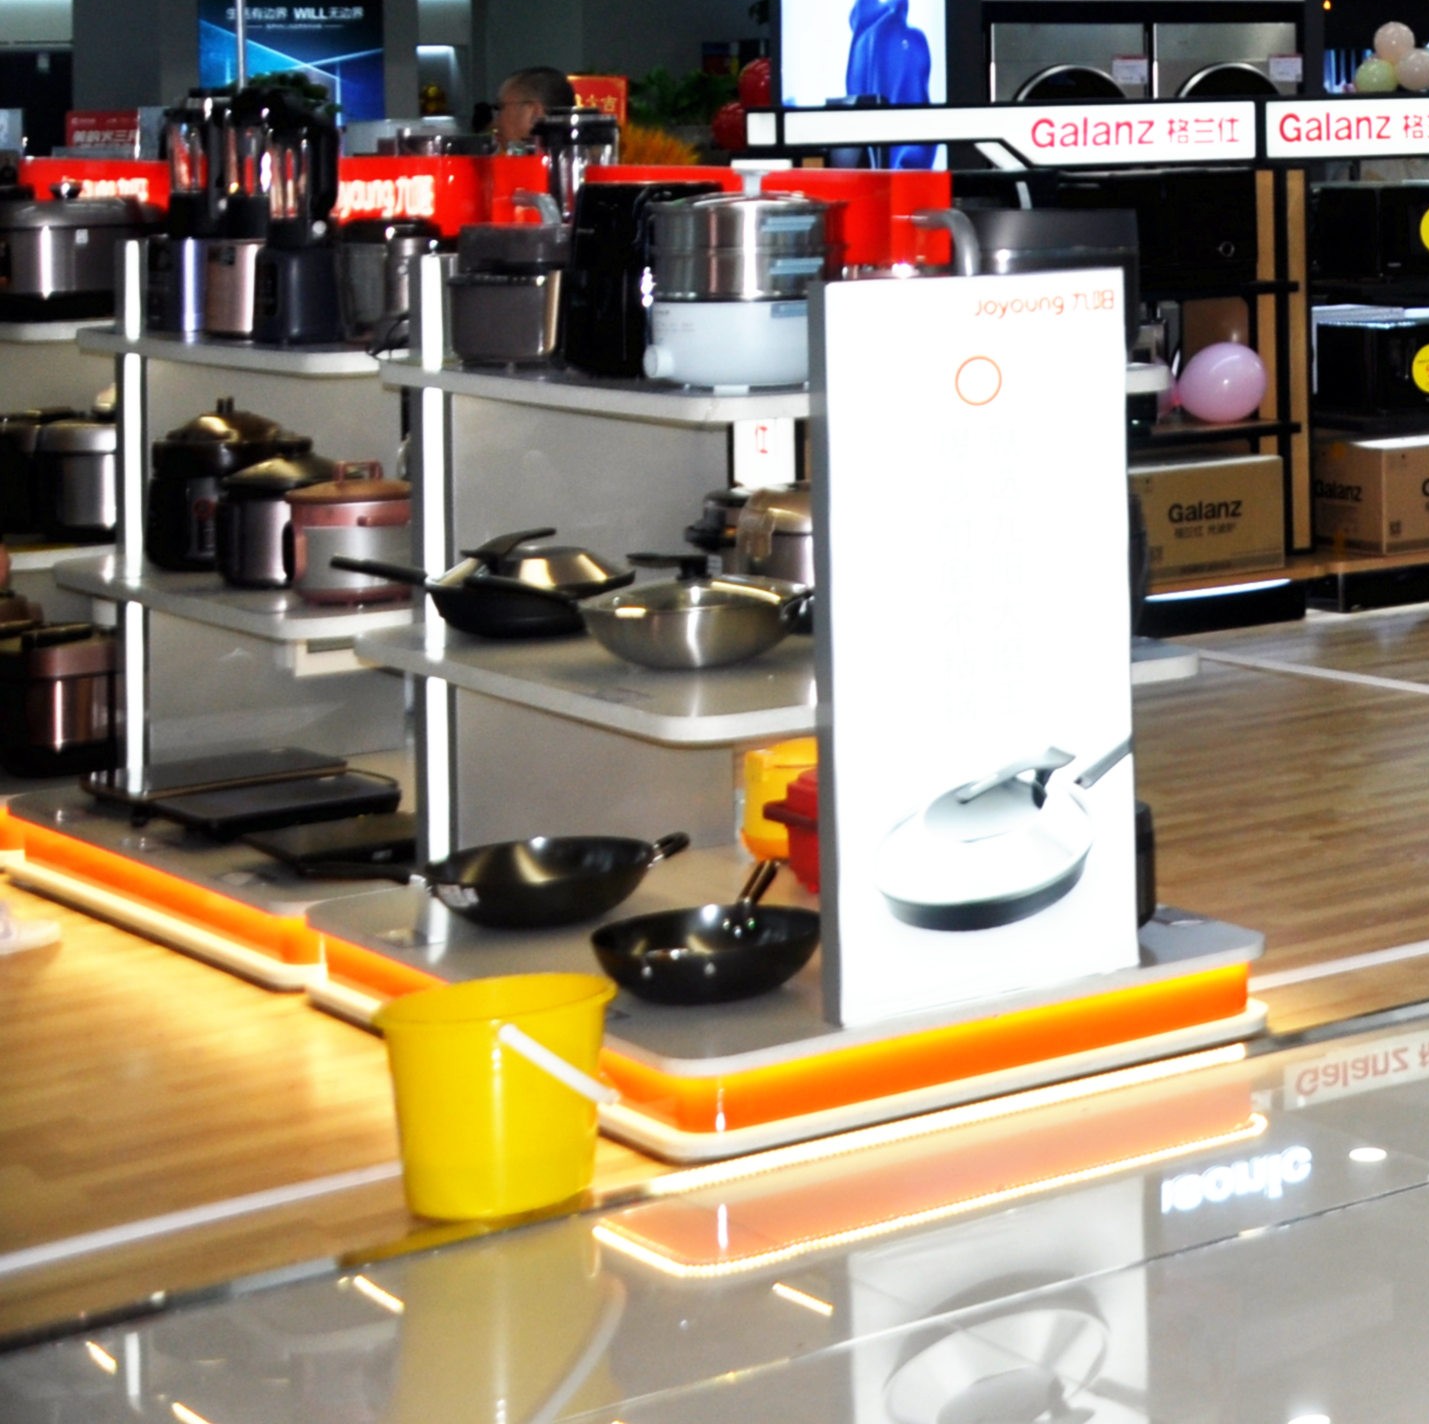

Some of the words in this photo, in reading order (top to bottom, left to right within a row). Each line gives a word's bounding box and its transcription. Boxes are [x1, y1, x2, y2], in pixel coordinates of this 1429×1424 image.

[1030, 117, 1156, 149] Galanz
[1167, 117, 1240, 145] 格兰仕
[1279, 112, 1392, 144] Galanz
[975, 293, 1065, 320] Joyoung
[1167, 498, 1244, 524] Galanz
